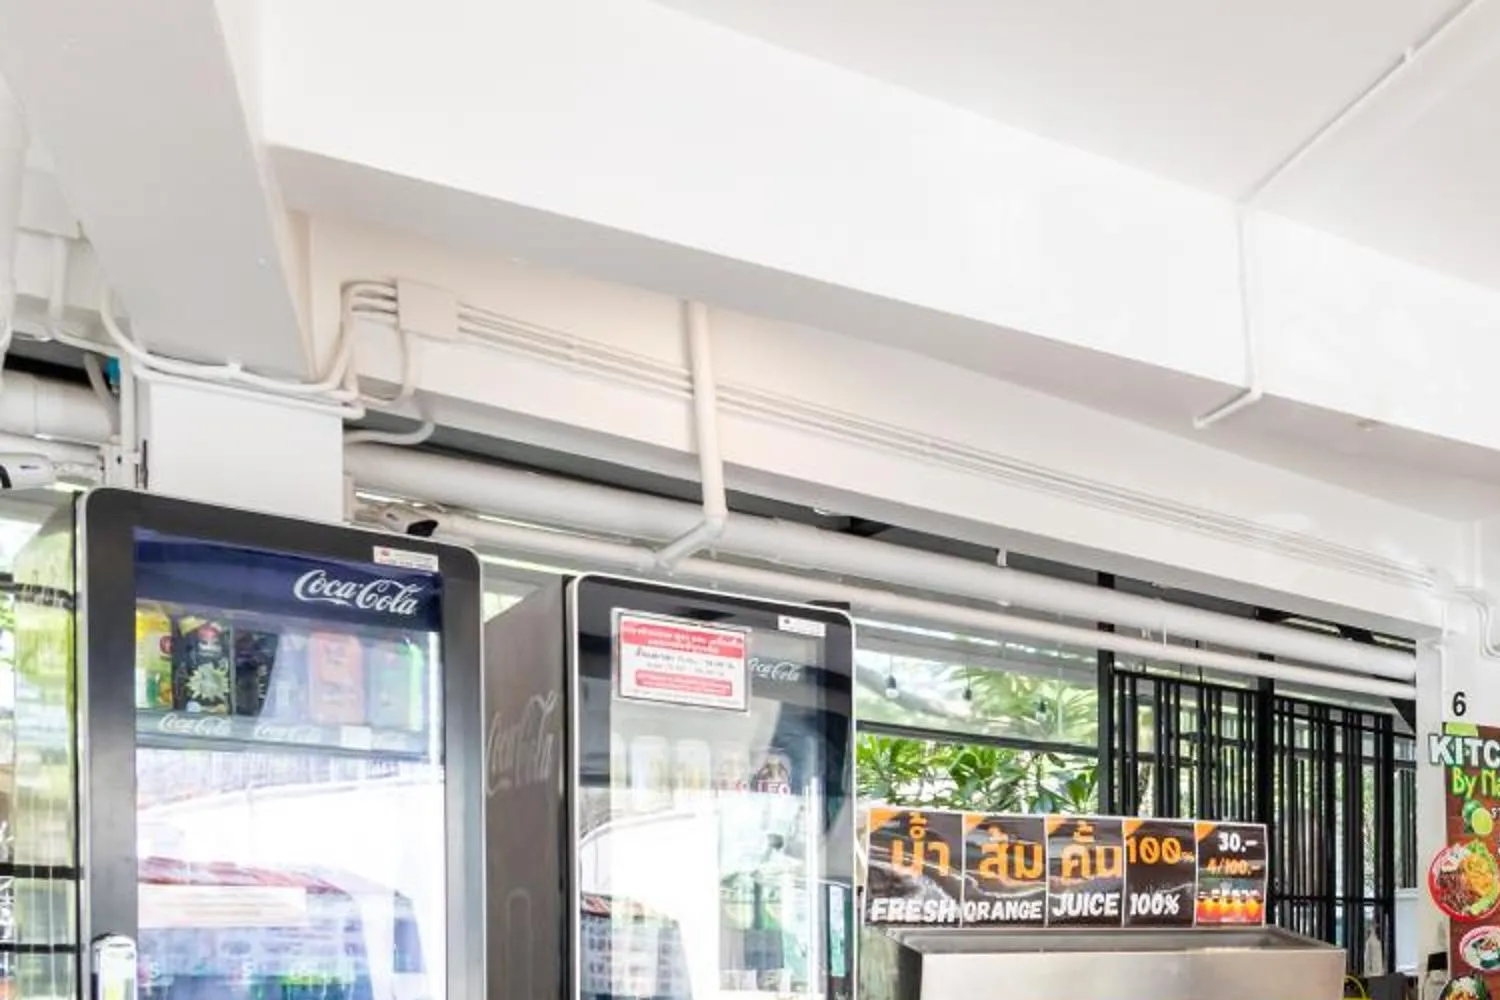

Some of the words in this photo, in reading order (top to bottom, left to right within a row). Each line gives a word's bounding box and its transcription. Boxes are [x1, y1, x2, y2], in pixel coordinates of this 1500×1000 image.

[293, 569, 421, 615] Coca-Cola
[1452, 691, 1466, 717] 6
[1452, 766, 1478, 801] By
[890, 812, 951, 877] น้ำ
[978, 826, 1043, 881] ส้ม
[1060, 820, 1122, 882] คั้น
[1217, 831, 1259, 854] 30.-
[870, 897, 960, 924] FRESH
[962, 899, 1043, 922] ORANGE
[1052, 893, 1120, 918] JUICE
[1129, 892, 1180, 917] 100%
